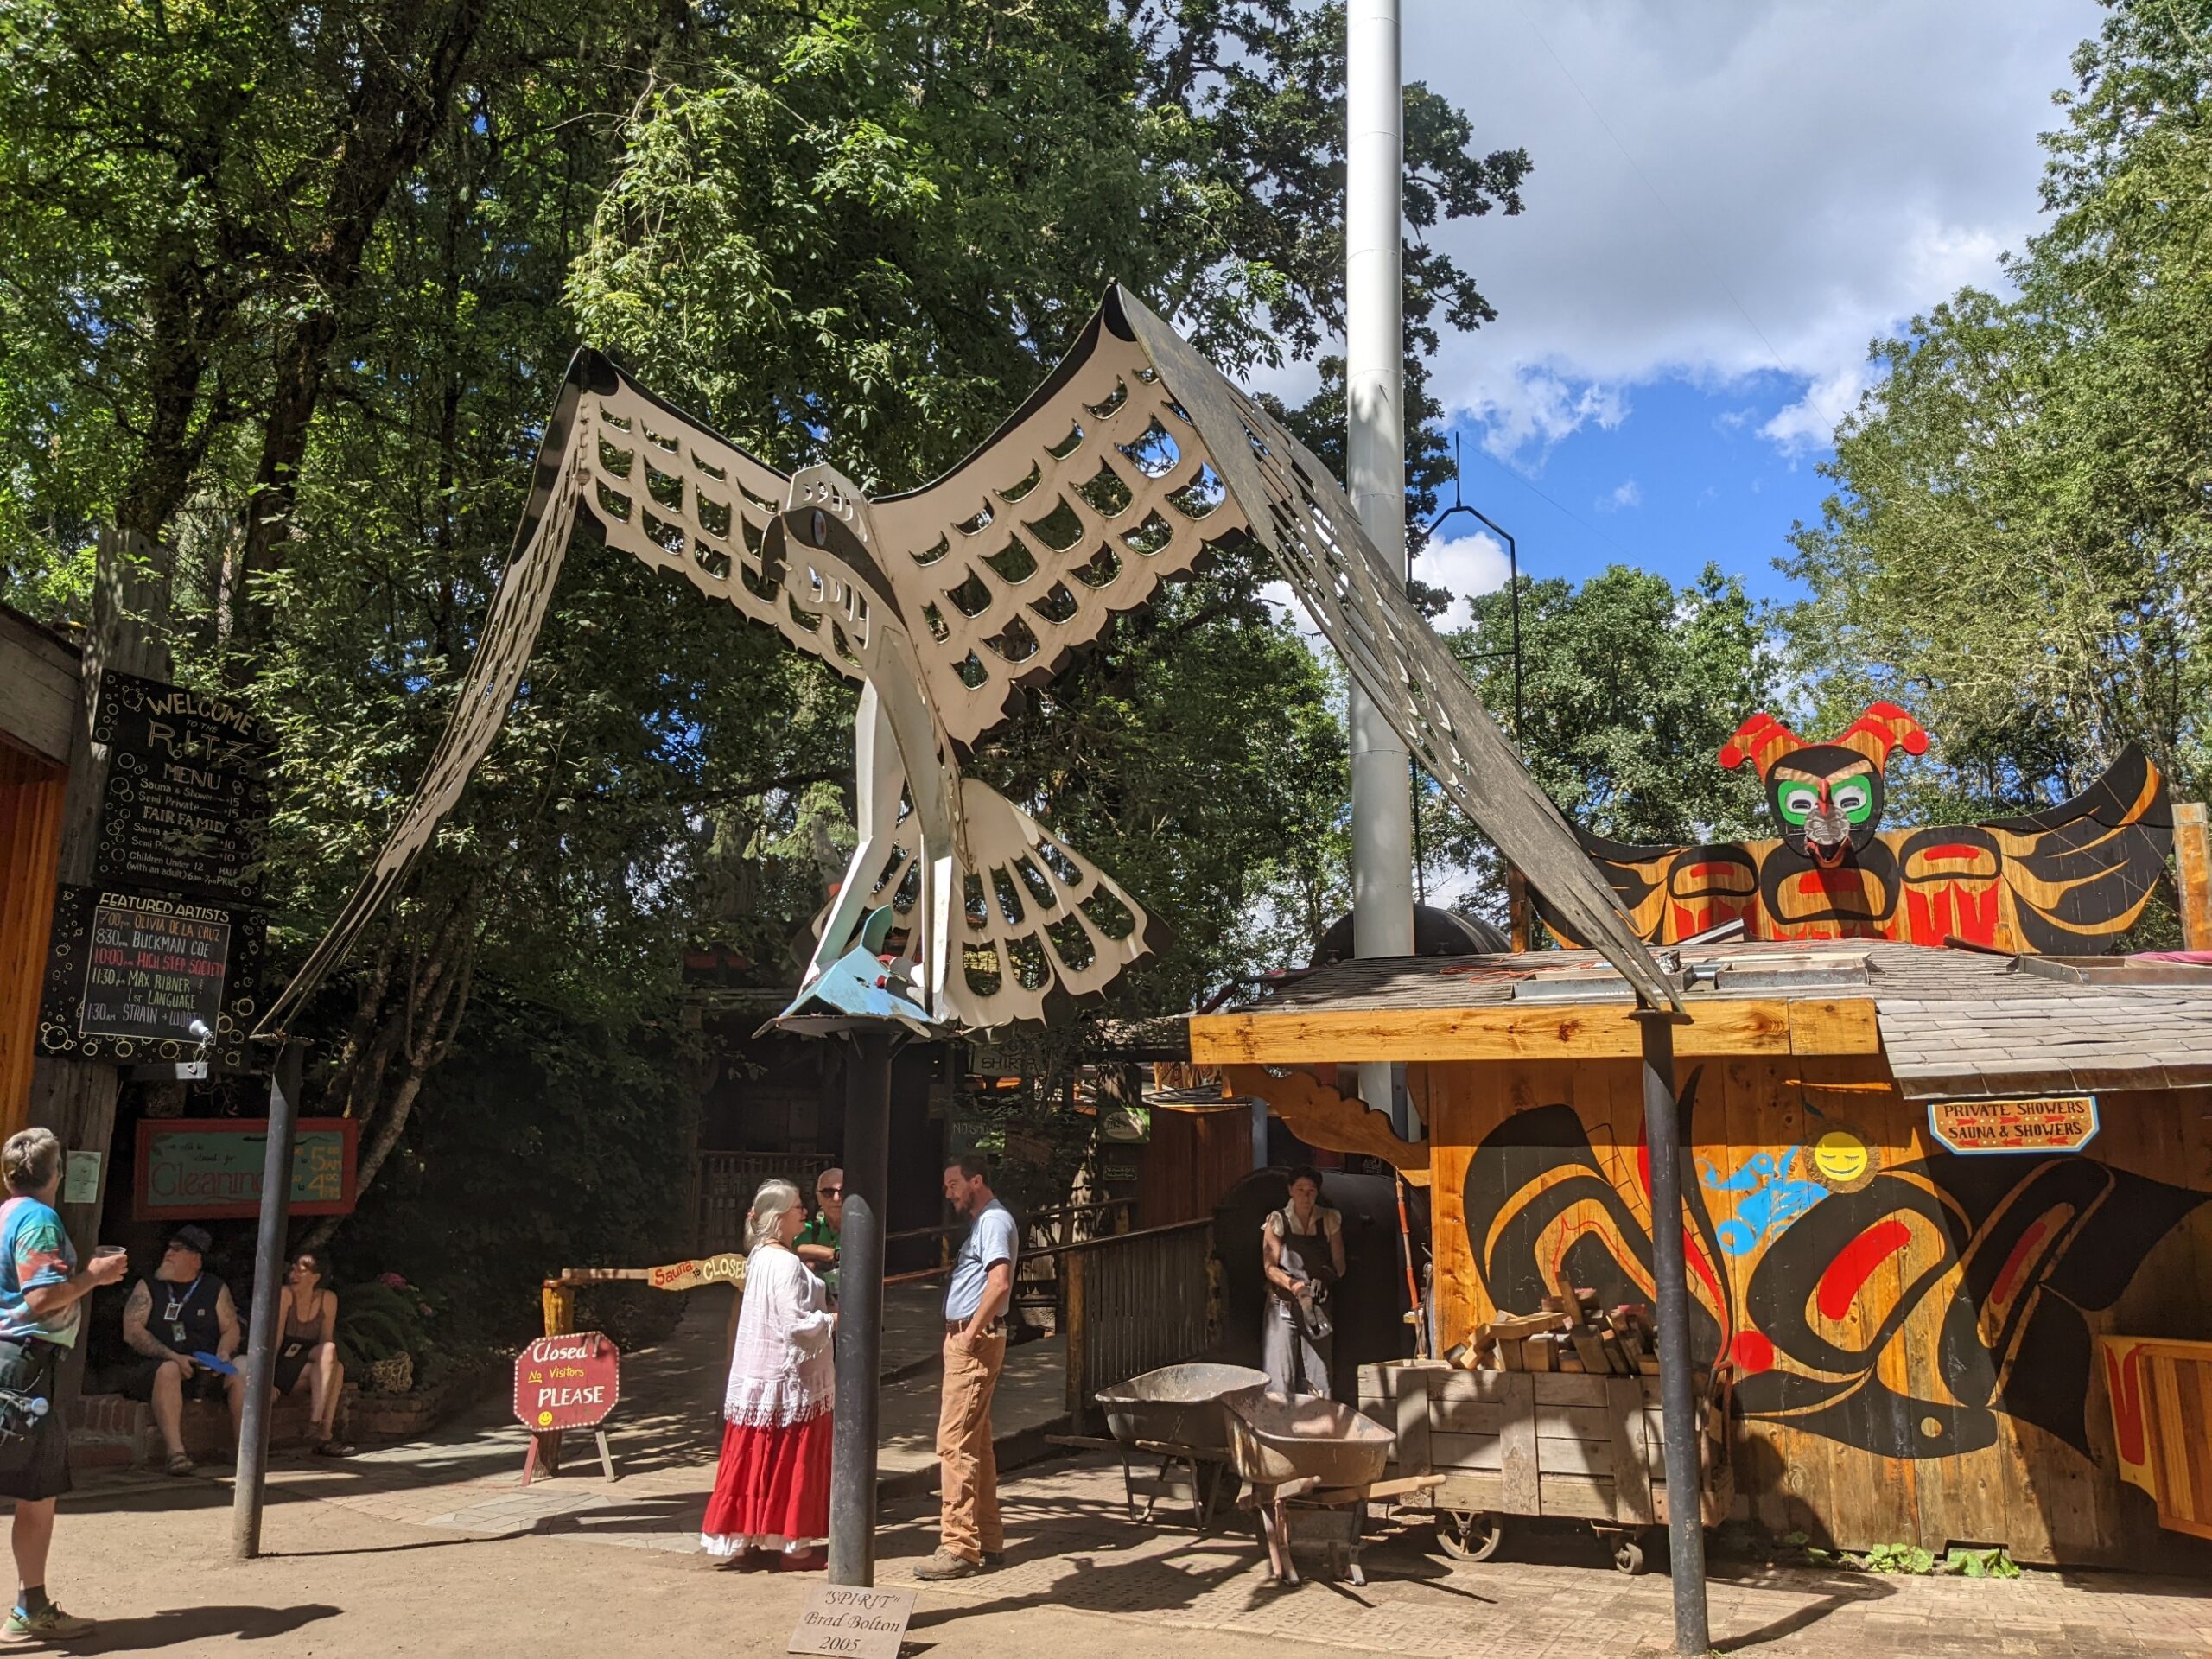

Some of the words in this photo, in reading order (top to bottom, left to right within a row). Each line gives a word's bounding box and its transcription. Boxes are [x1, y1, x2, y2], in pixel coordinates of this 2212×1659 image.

[147, 693, 256, 735] WELCOME
[187, 719, 198, 728] TO
[200, 723, 219, 733] THE
[148, 717, 254, 763] RITZ
[163, 763, 221, 790] MENU
[138, 791, 161, 804] Semi
[166, 796, 199, 810] Private
[140, 778, 171, 793] Sauna
[183, 787, 213, 801] Shower
[133, 823, 160, 836] Sauna
[143, 805, 175, 823] FAIR
[177, 812, 230, 834] FAMILY
[131, 836, 152, 849] Semi
[126, 861, 147, 872] (with
[149, 866, 159, 874] an
[162, 868, 187, 880] adult)
[216, 876, 239, 887] PRICE
[130, 851, 164, 865] Children
[166, 857, 190, 868] Under
[194, 862, 204, 871] 12
[219, 867, 238, 877] HALF
[99, 892, 173, 914] FEATURED
[175, 904, 230, 923] ARTISTS
[135, 914, 165, 932] OLIVIA
[169, 919, 179, 935] DE
[181, 923, 194, 937] LA
[199, 925, 220, 942] CRUZ
[132, 931, 186, 955] BUCKMAN
[191, 942, 209, 957] COE
[137, 951, 161, 969] HIGH
[164, 955, 187, 972] STEP
[188, 959, 226, 977] SOCIETY
[128, 969, 149, 988] MAX
[154, 975, 190, 992] RIBNER
[148, 989, 195, 1011] LANGUAGE
[123, 1003, 157, 1025] STRAIN
[1944, 1104, 2011, 1117] PRIVATE
[2018, 1101, 2085, 1116] SHOWERS
[1949, 1126, 1996, 1139] SAUNA
[1999, 1126, 2009, 1137] &
[2014, 1122, 2082, 1137] SHOWERS
[654, 1261, 693, 1286] Sauna
[703, 1258, 747, 1281] CLOSED
[532, 1333, 601, 1363] Closed!
[528, 1370, 543, 1382] No
[550, 1364, 586, 1379] Visitors
[537, 1386, 605, 1408] PLEASE
[825, 1590, 901, 1610] "SPIRIT"
[804, 1611, 849, 1628] Brad
[848, 1614, 900, 1632] Bolton
[819, 1636, 862, 1652] 2005
